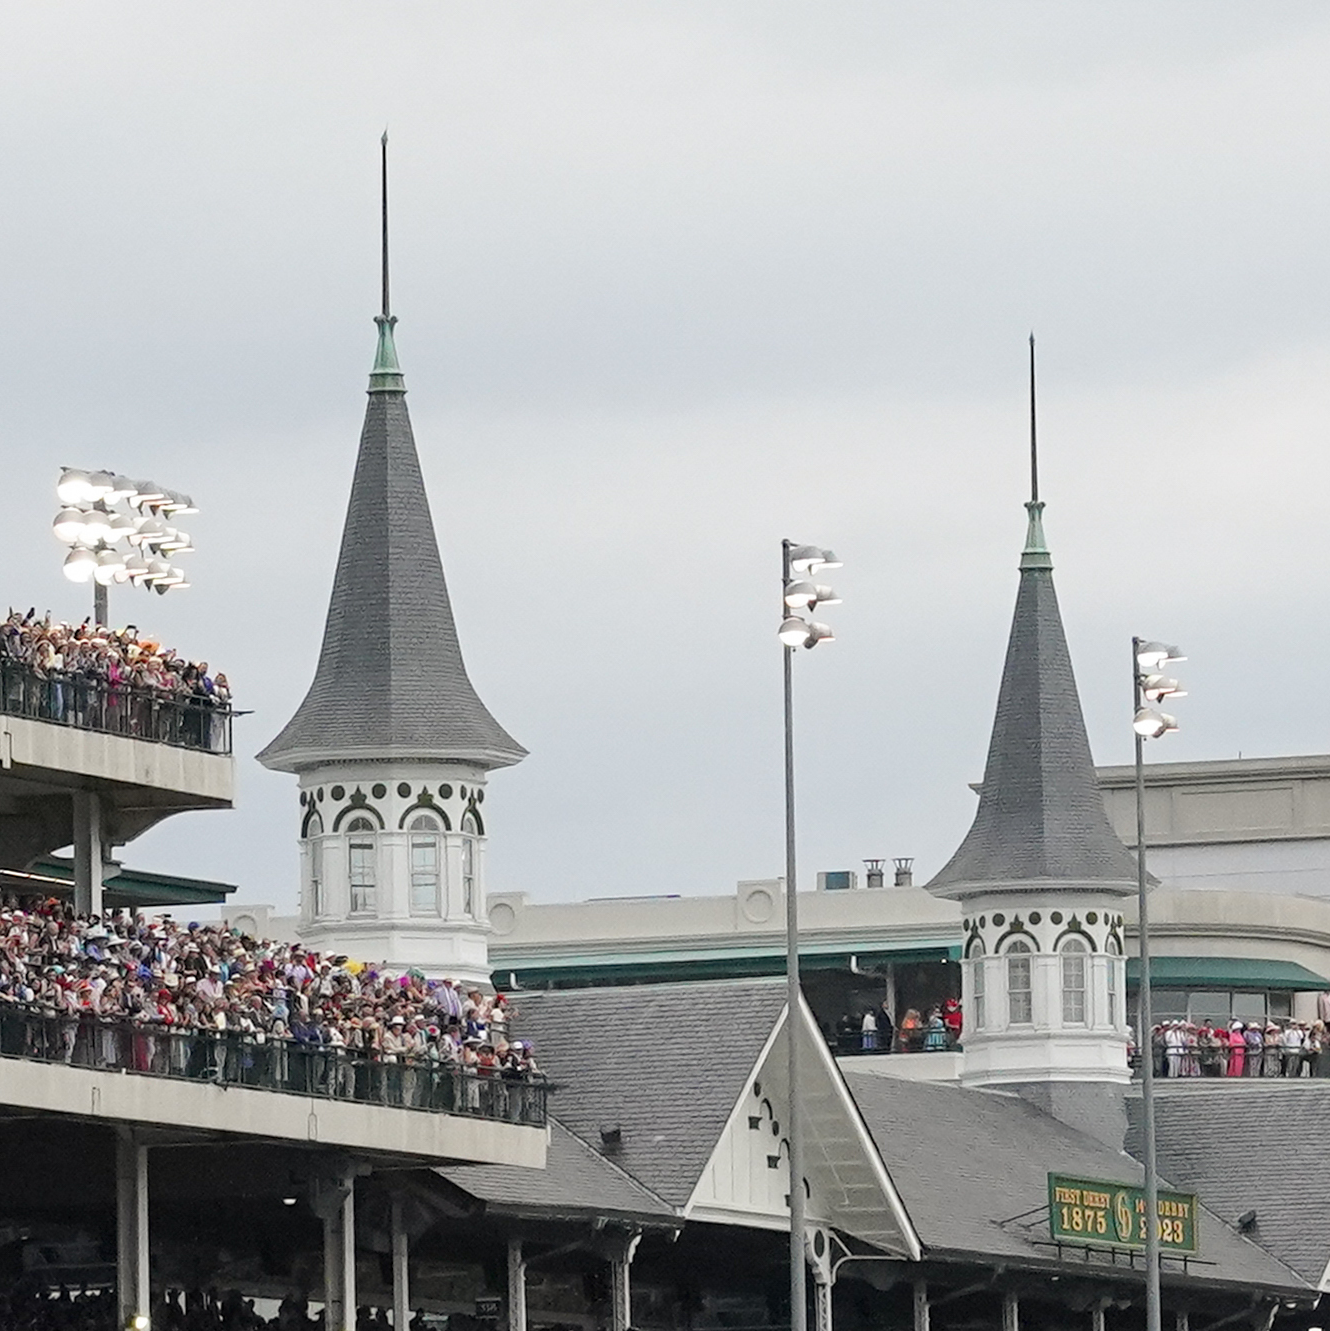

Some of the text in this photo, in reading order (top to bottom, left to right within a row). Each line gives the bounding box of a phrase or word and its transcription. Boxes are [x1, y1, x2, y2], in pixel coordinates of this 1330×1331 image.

[1055, 1187, 1110, 1209] FIRST DERBY
[1158, 1200, 1190, 1218] DERBY
[1061, 1206, 1107, 1234] 1875
